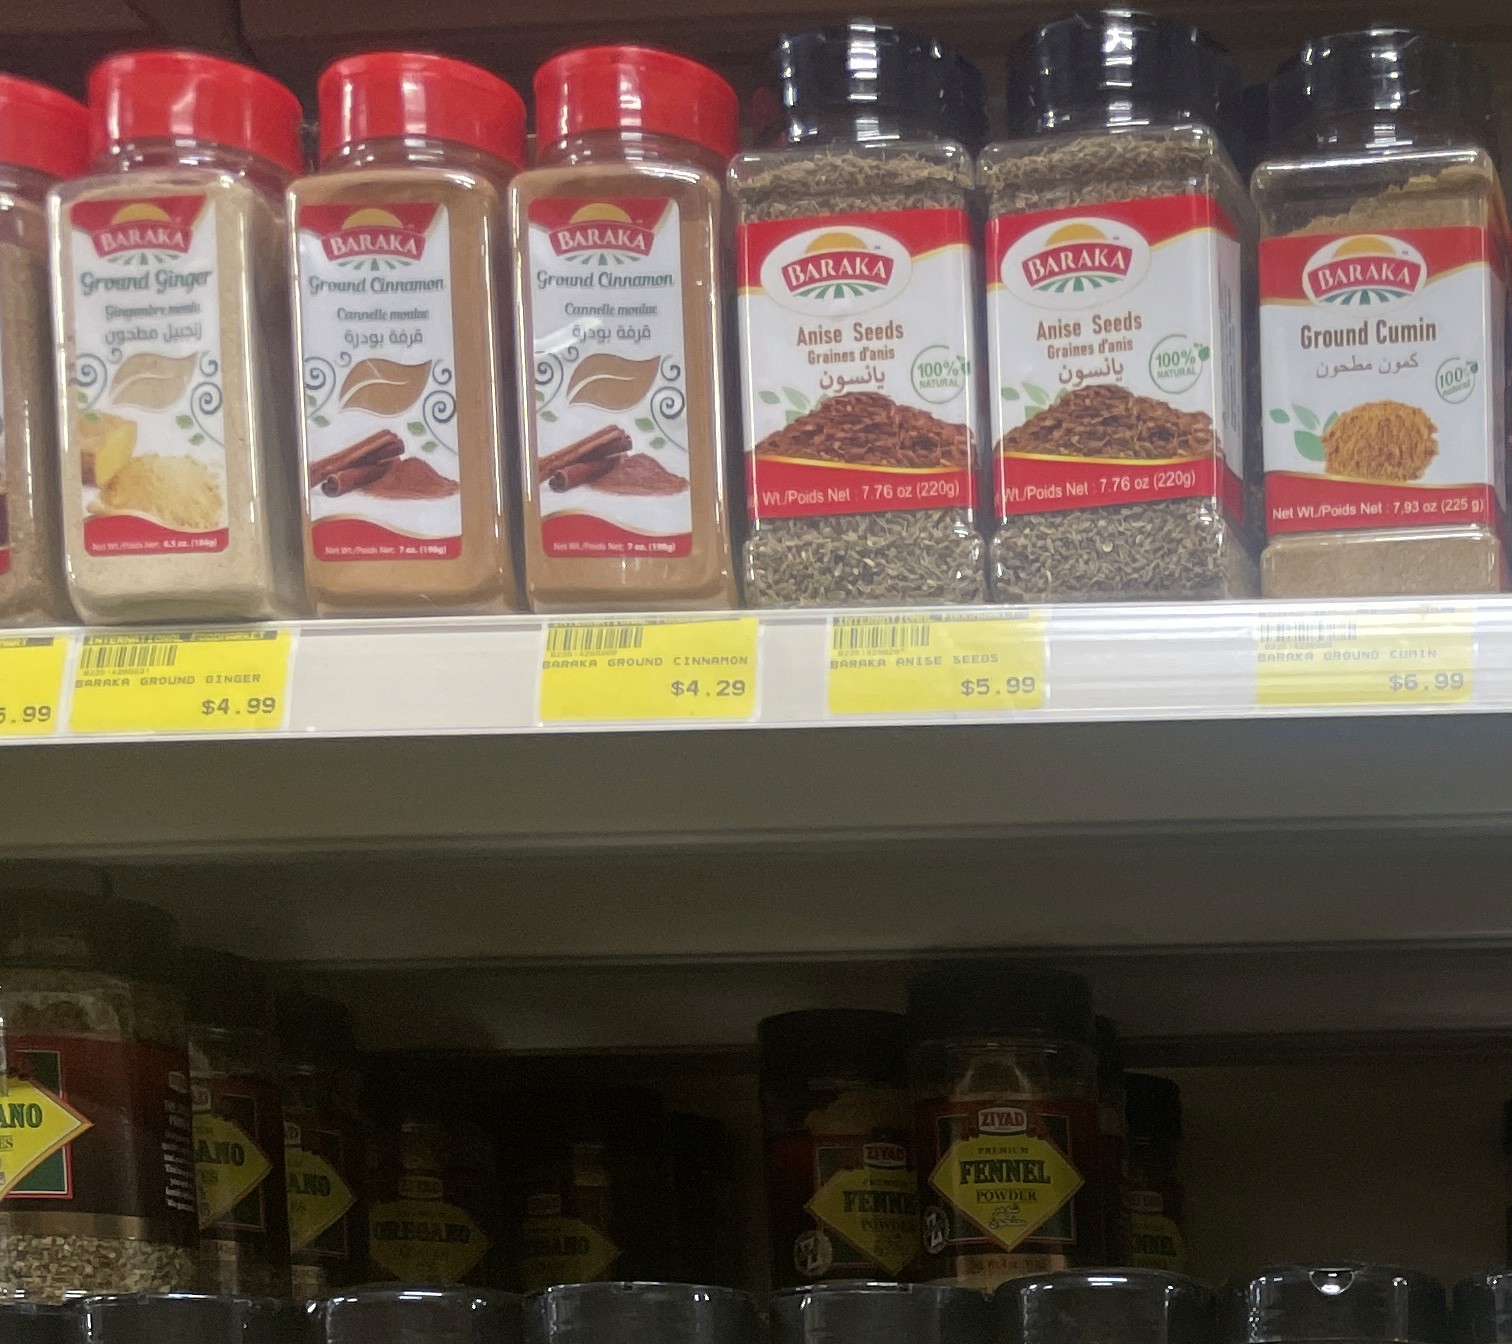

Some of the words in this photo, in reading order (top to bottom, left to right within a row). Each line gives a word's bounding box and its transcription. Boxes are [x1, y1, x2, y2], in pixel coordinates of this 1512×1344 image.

[330, 230, 418, 257] BARAKA
[787, 258, 888, 288] BARAKA
[1027, 248, 1127, 283] BARAKA
[1317, 261, 1412, 290] BARAKA
[309, 274, 366, 295] Ground
[371, 273, 444, 293] Cinnamon
[797, 325, 842, 347] Anise
[853, 322, 904, 342] Seeds
[1300, 323, 1369, 350] Ground
[1375, 318, 1437, 344] Cumin
[807, 348, 856, 365] Graines
[859, 345, 895, 362] d'anis
[1380, 353, 1420, 371] كمون
[917, 360, 959, 378] 100%
[1315, 357, 1374, 379] مطحون
[819, 368, 887, 391] يانسون
[919, 375, 959, 390] NATURAL
[543, 659, 597, 670] BARAKA
[607, 657, 663, 667] GROUND
[673, 654, 748, 666] CINNAMON
[670, 678, 746, 699] $4.29
[961, 676, 1036, 697] $5.99
[1388, 671, 1464, 692] $6.99
[201, 696, 277, 718] $4.99
